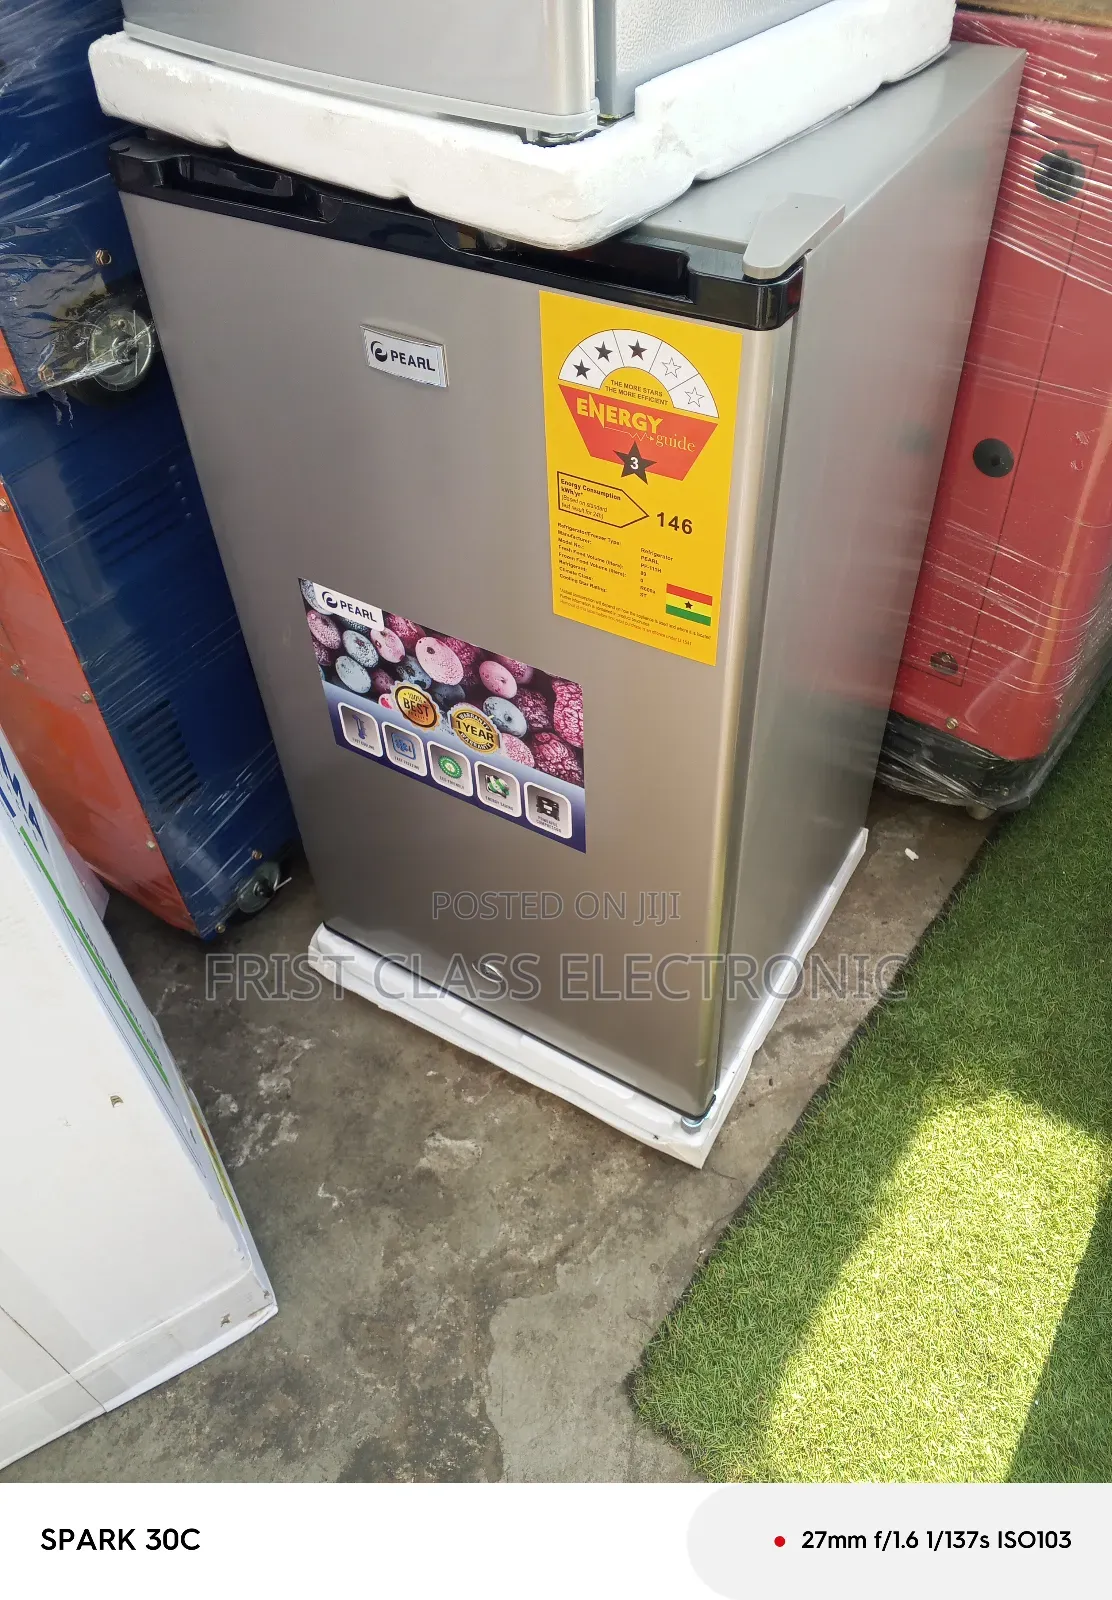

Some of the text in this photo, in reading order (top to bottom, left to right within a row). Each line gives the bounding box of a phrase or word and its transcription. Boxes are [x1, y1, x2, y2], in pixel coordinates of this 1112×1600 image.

[390, 349, 436, 372] PEARL
[605, 385, 668, 406] THE MORE EFFICIENT
[610, 379, 662, 397] THE MORE STARS
[576, 394, 664, 434] ENERGY
[655, 433, 696, 453] guide
[630, 455, 638, 470] 3
[560, 478, 621, 501] Energy Consumption
[656, 511, 693, 535] 146
[640, 547, 672, 562] Refrigerator
[640, 555, 659, 564] PEARL
[339, 599, 376, 622] PEARL
[403, 697, 429, 717] BEST
[456, 720, 494, 743] 1 YEAR
